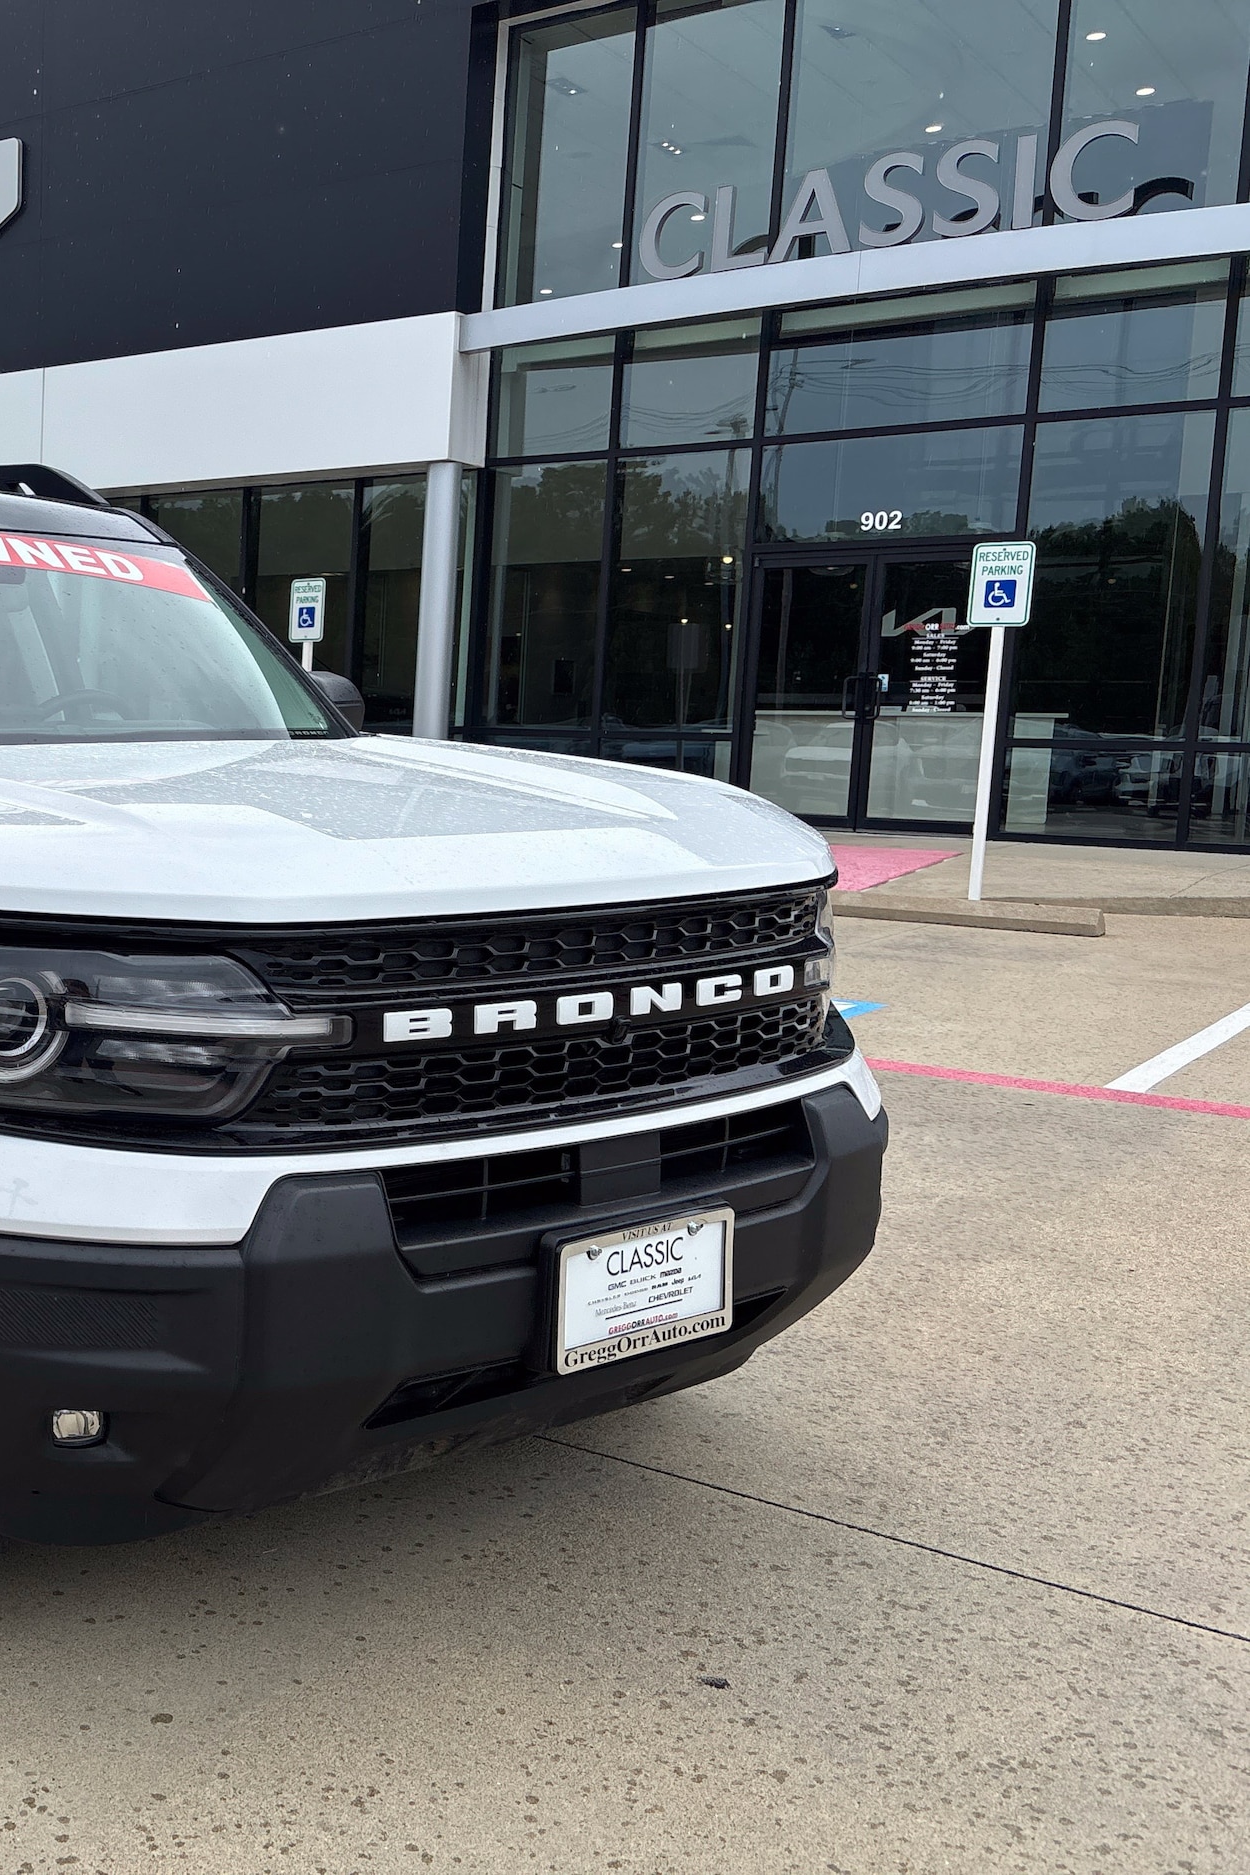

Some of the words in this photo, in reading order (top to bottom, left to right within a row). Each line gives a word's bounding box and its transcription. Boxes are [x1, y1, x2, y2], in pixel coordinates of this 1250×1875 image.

[639, 120, 1140, 280] CLASSIC
[860, 510, 903, 531] 902
[979, 551, 1029, 562] RESERVED
[981, 565, 1024, 576] PARKING
[294, 585, 322, 593] RESERVED
[383, 965, 794, 1042] BRONCO
[622, 1228, 646, 1241] VISIT
[647, 1226, 660, 1235] US
[661, 1222, 673, 1232] AT
[606, 1237, 683, 1276] CLASSIC
[608, 1280, 627, 1291] GMC
[648, 1286, 694, 1303] CHEVROLET
[608, 1312, 679, 1335] GREGGORRAUTO.com
[564, 1315, 726, 1368] GreggOrrAuto.com
